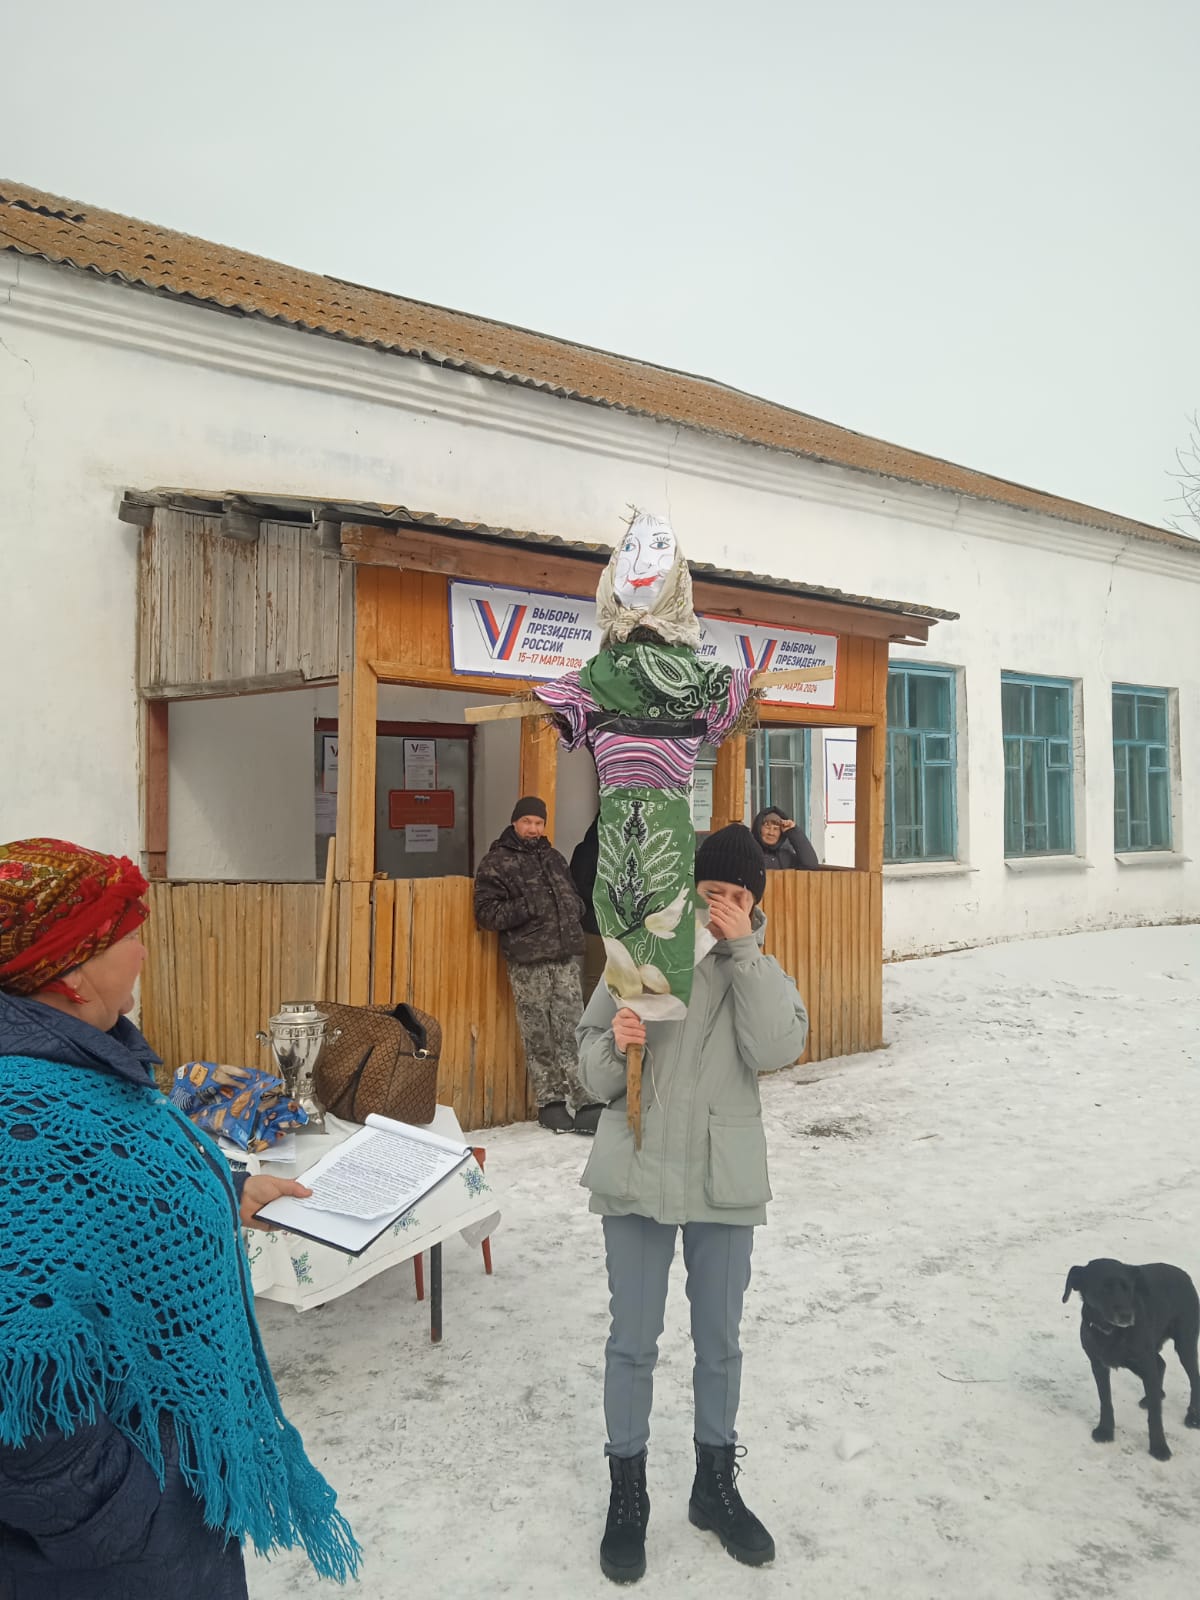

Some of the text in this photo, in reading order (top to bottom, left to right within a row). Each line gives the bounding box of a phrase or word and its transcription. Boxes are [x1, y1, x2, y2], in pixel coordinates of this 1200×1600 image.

[532, 607, 580, 625] ВЫБОРЫ
[526, 622, 593, 642] ПРЕЗИДЕНТА
[521, 637, 564, 653] РОССИИ
[780, 641, 817, 655] ВЫБОРЫ
[539, 654, 566, 668] МАРТА
[566, 657, 583, 669] 2024
[775, 654, 826, 669] ПРЕЗИДЕНТА
